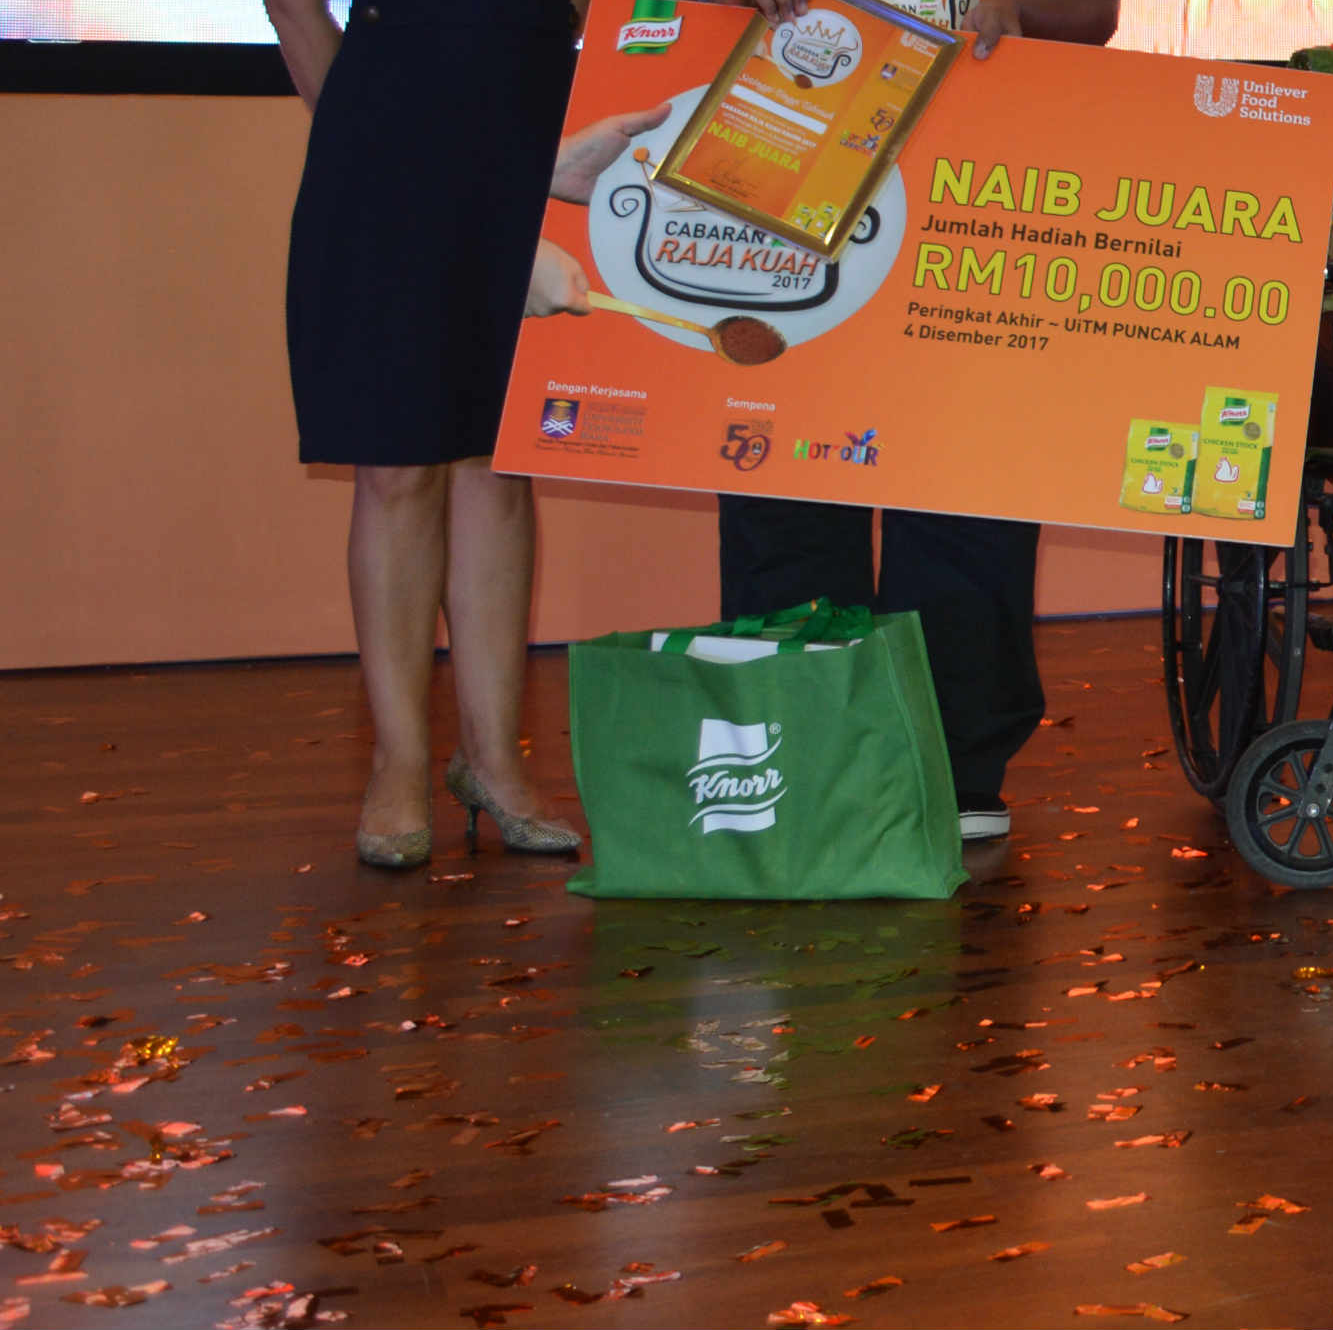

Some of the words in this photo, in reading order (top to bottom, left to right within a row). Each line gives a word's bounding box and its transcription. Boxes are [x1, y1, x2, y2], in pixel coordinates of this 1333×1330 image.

[622, 24, 677, 42] Knorr
[1241, 93, 1278, 109] Food
[1243, 80, 1309, 100] Unilever
[1239, 105, 1312, 127] Solutions
[707, 120, 749, 149] NAIB
[749, 140, 802, 175] JUARA
[928, 156, 1084, 217] NAIB
[1094, 176, 1304, 244] JUARA
[664, 220, 767, 245] CABARAN
[921, 213, 1004, 239] Jumlah
[1010, 223, 1087, 249] Hadiah
[1094, 231, 1183, 258] Bernilai
[655, 238, 733, 270] RAJA
[739, 248, 820, 277] KUAH
[771, 274, 812, 290] 2017
[912, 241, 1290, 327] RM10,000.00
[903, 323, 914, 340] 4
[918, 324, 1003, 347] Disember
[1006, 332, 1050, 352] 2017
[907, 301, 995, 326] Peringkat
[996, 311, 1043, 329] Akhir
[1063, 317, 1109, 336] UiTM
[1112, 321, 1187, 345] PUNCAK
[1189, 331, 1242, 351] ALAM
[547, 380, 588, 395] Dengan
[590, 385, 648, 401] Kerjasama
[726, 397, 777, 413] Sempena
[688, 768, 784, 805] Knorr
